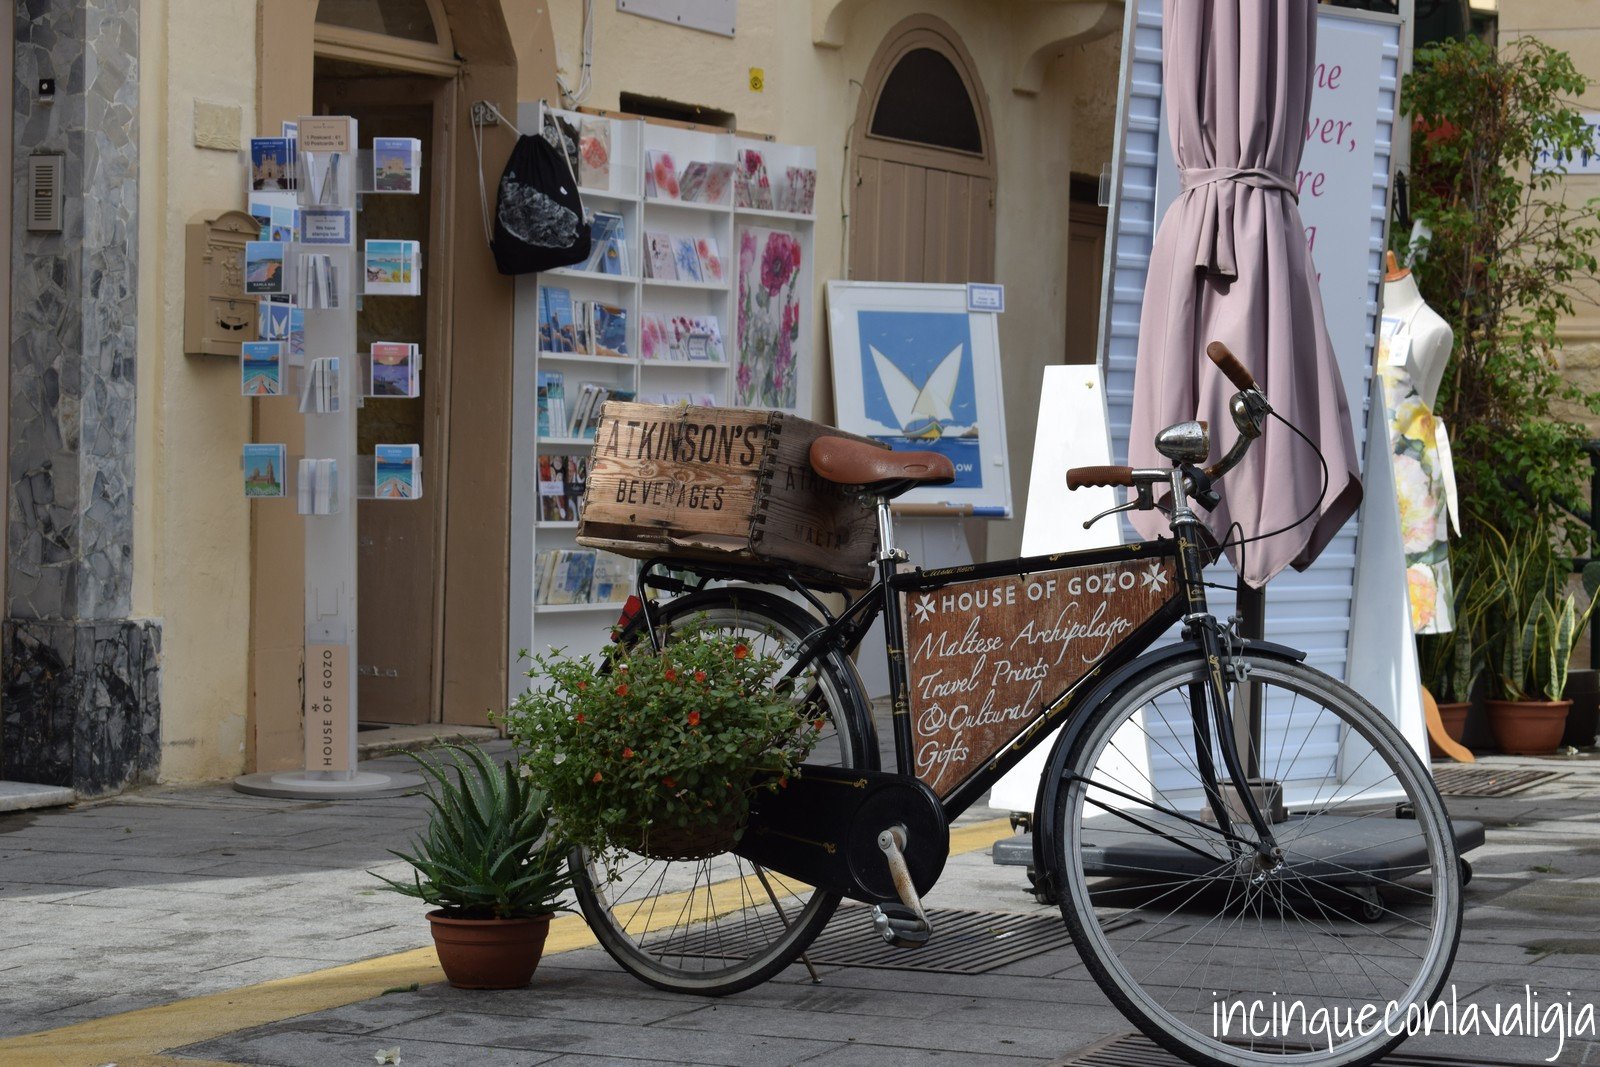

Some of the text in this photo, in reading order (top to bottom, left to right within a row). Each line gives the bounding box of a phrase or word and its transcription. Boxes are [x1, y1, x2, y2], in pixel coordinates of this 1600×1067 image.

[603, 419, 758, 466] ATKINSON'S
[616, 478, 725, 511] BEVERAGES
[941, 571, 1136, 614] HOUSE OF GOZO
[913, 601, 1132, 666] Maltese Archipelago
[917, 653, 1049, 700] Travel Prints
[322, 649, 333, 766] HOUSE OF GOZO
[915, 730, 970, 789] Gifts
